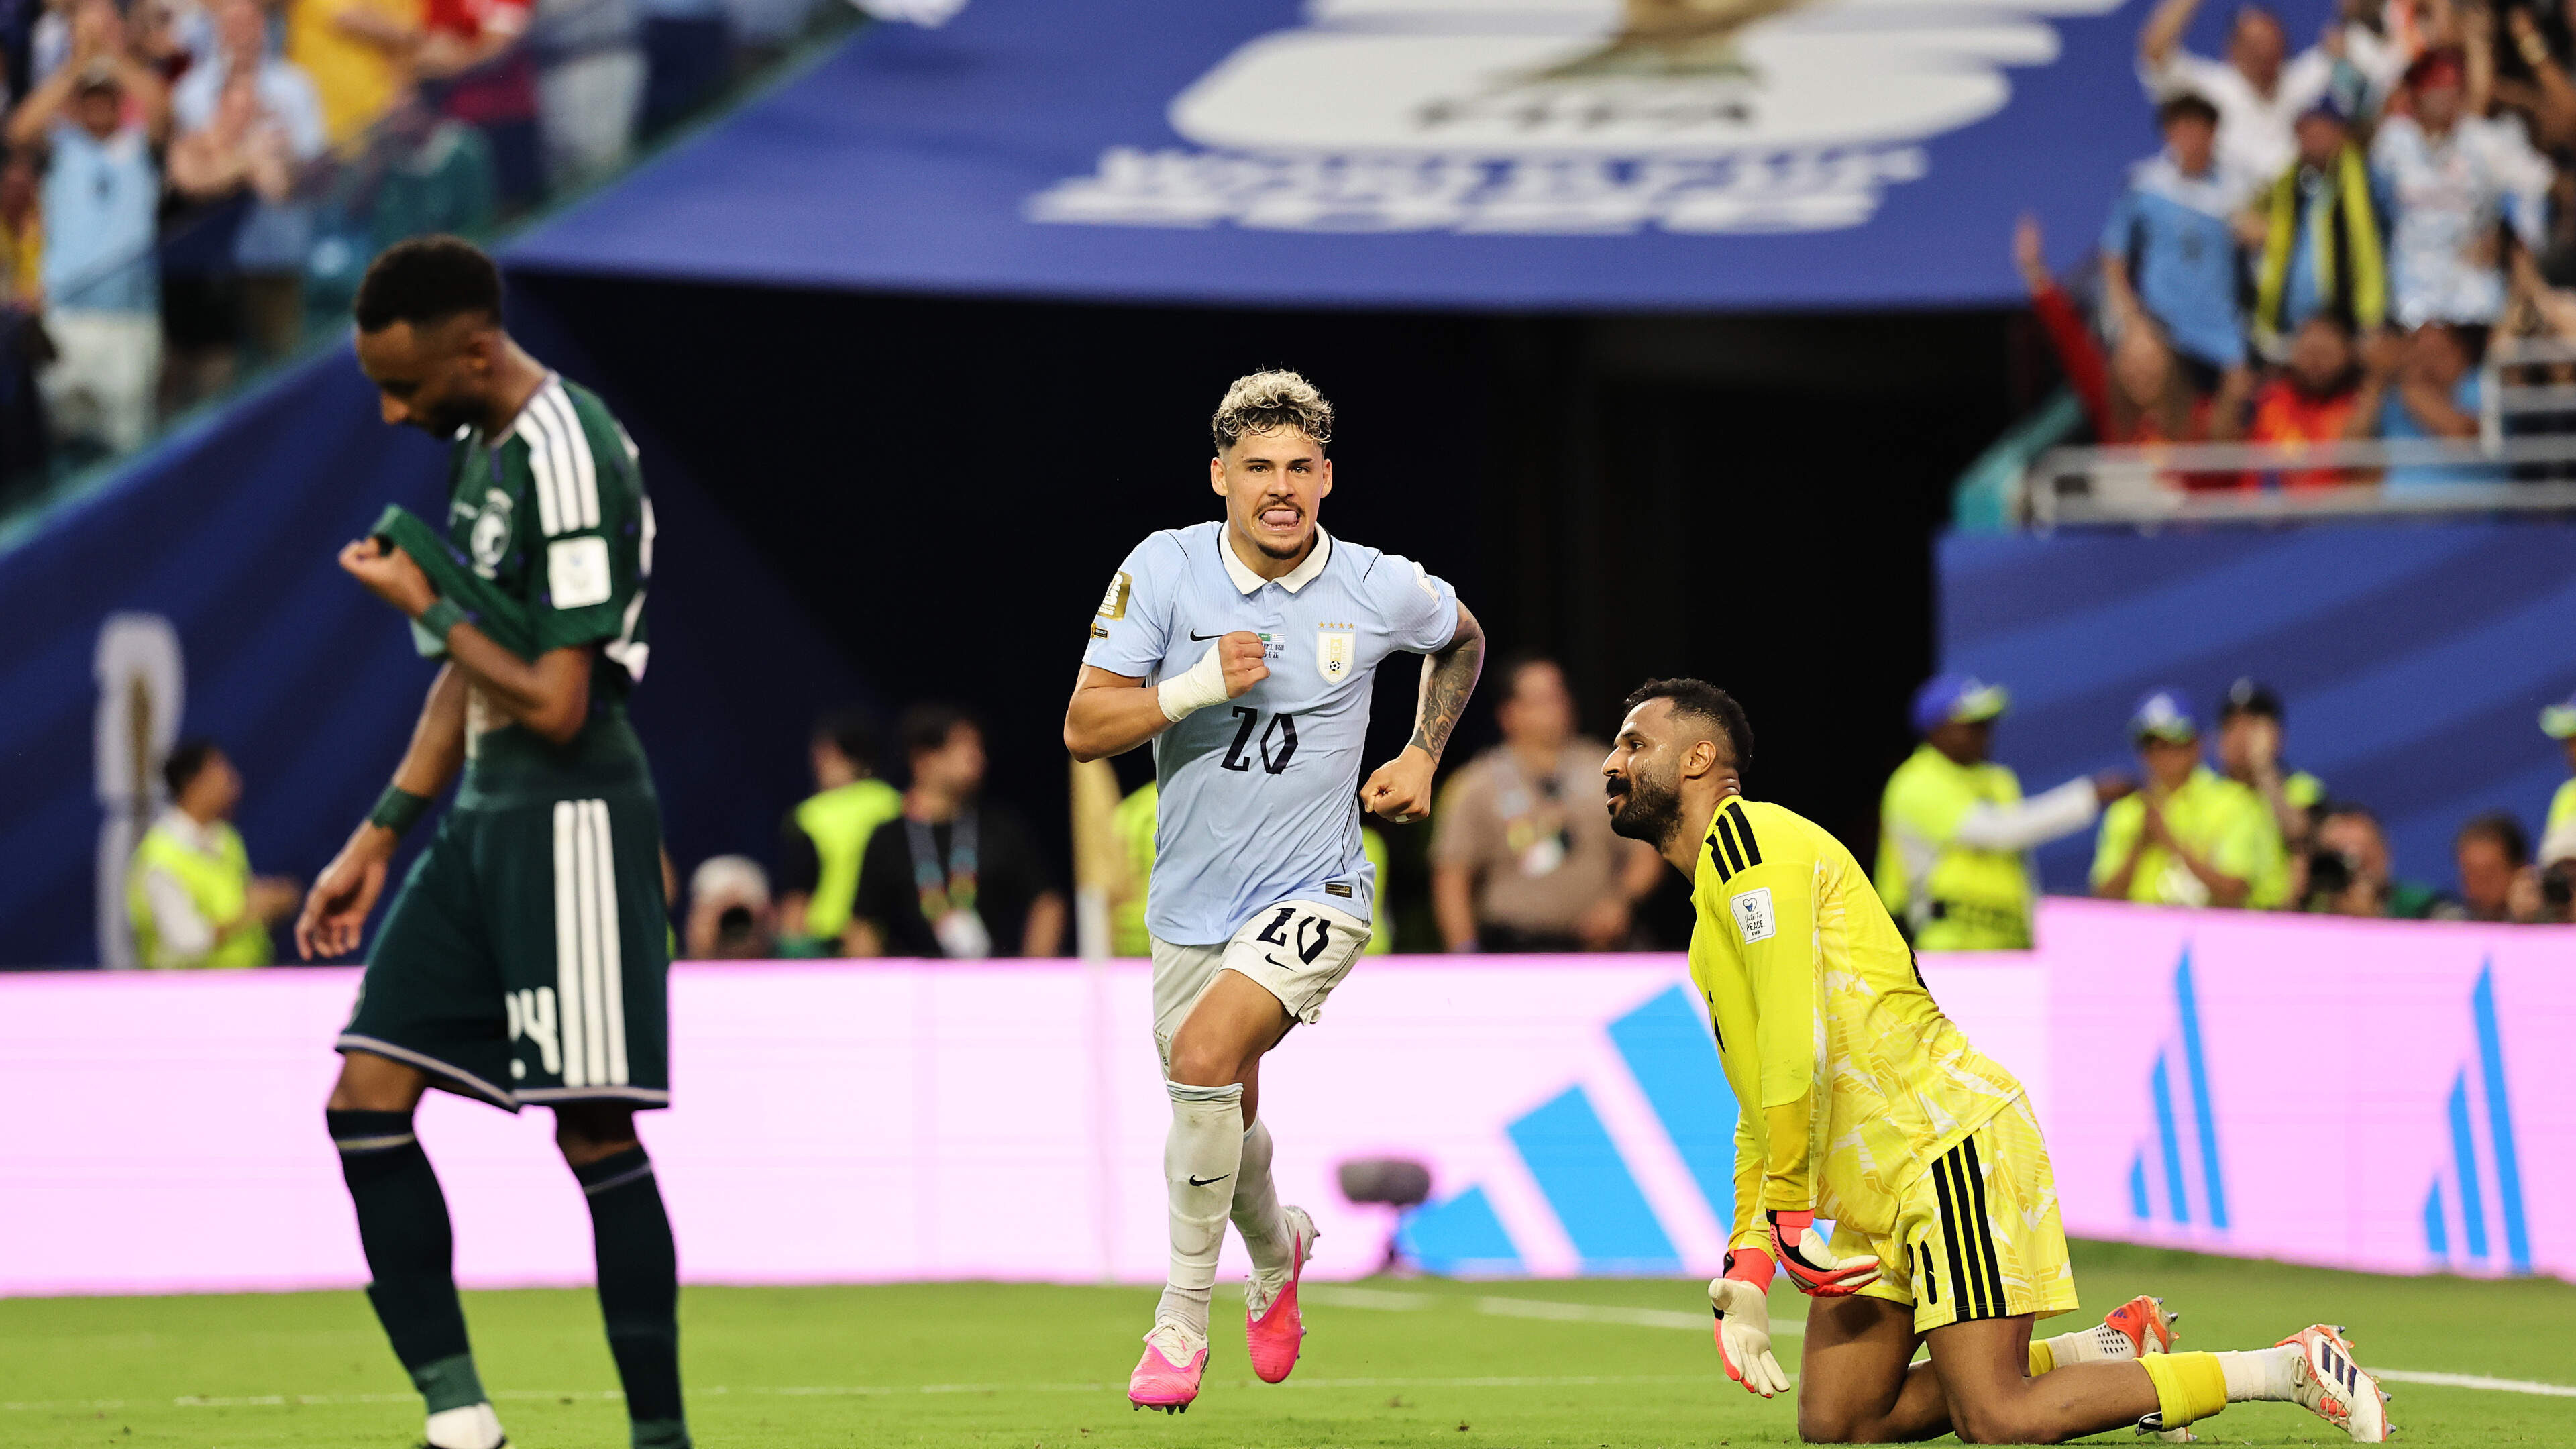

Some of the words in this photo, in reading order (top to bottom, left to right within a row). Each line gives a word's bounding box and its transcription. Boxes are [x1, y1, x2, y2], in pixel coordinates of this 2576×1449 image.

[1220, 706, 1299, 775] 20
[1256, 908, 1332, 965] 20
[1746, 920, 1764, 932] PEACE
